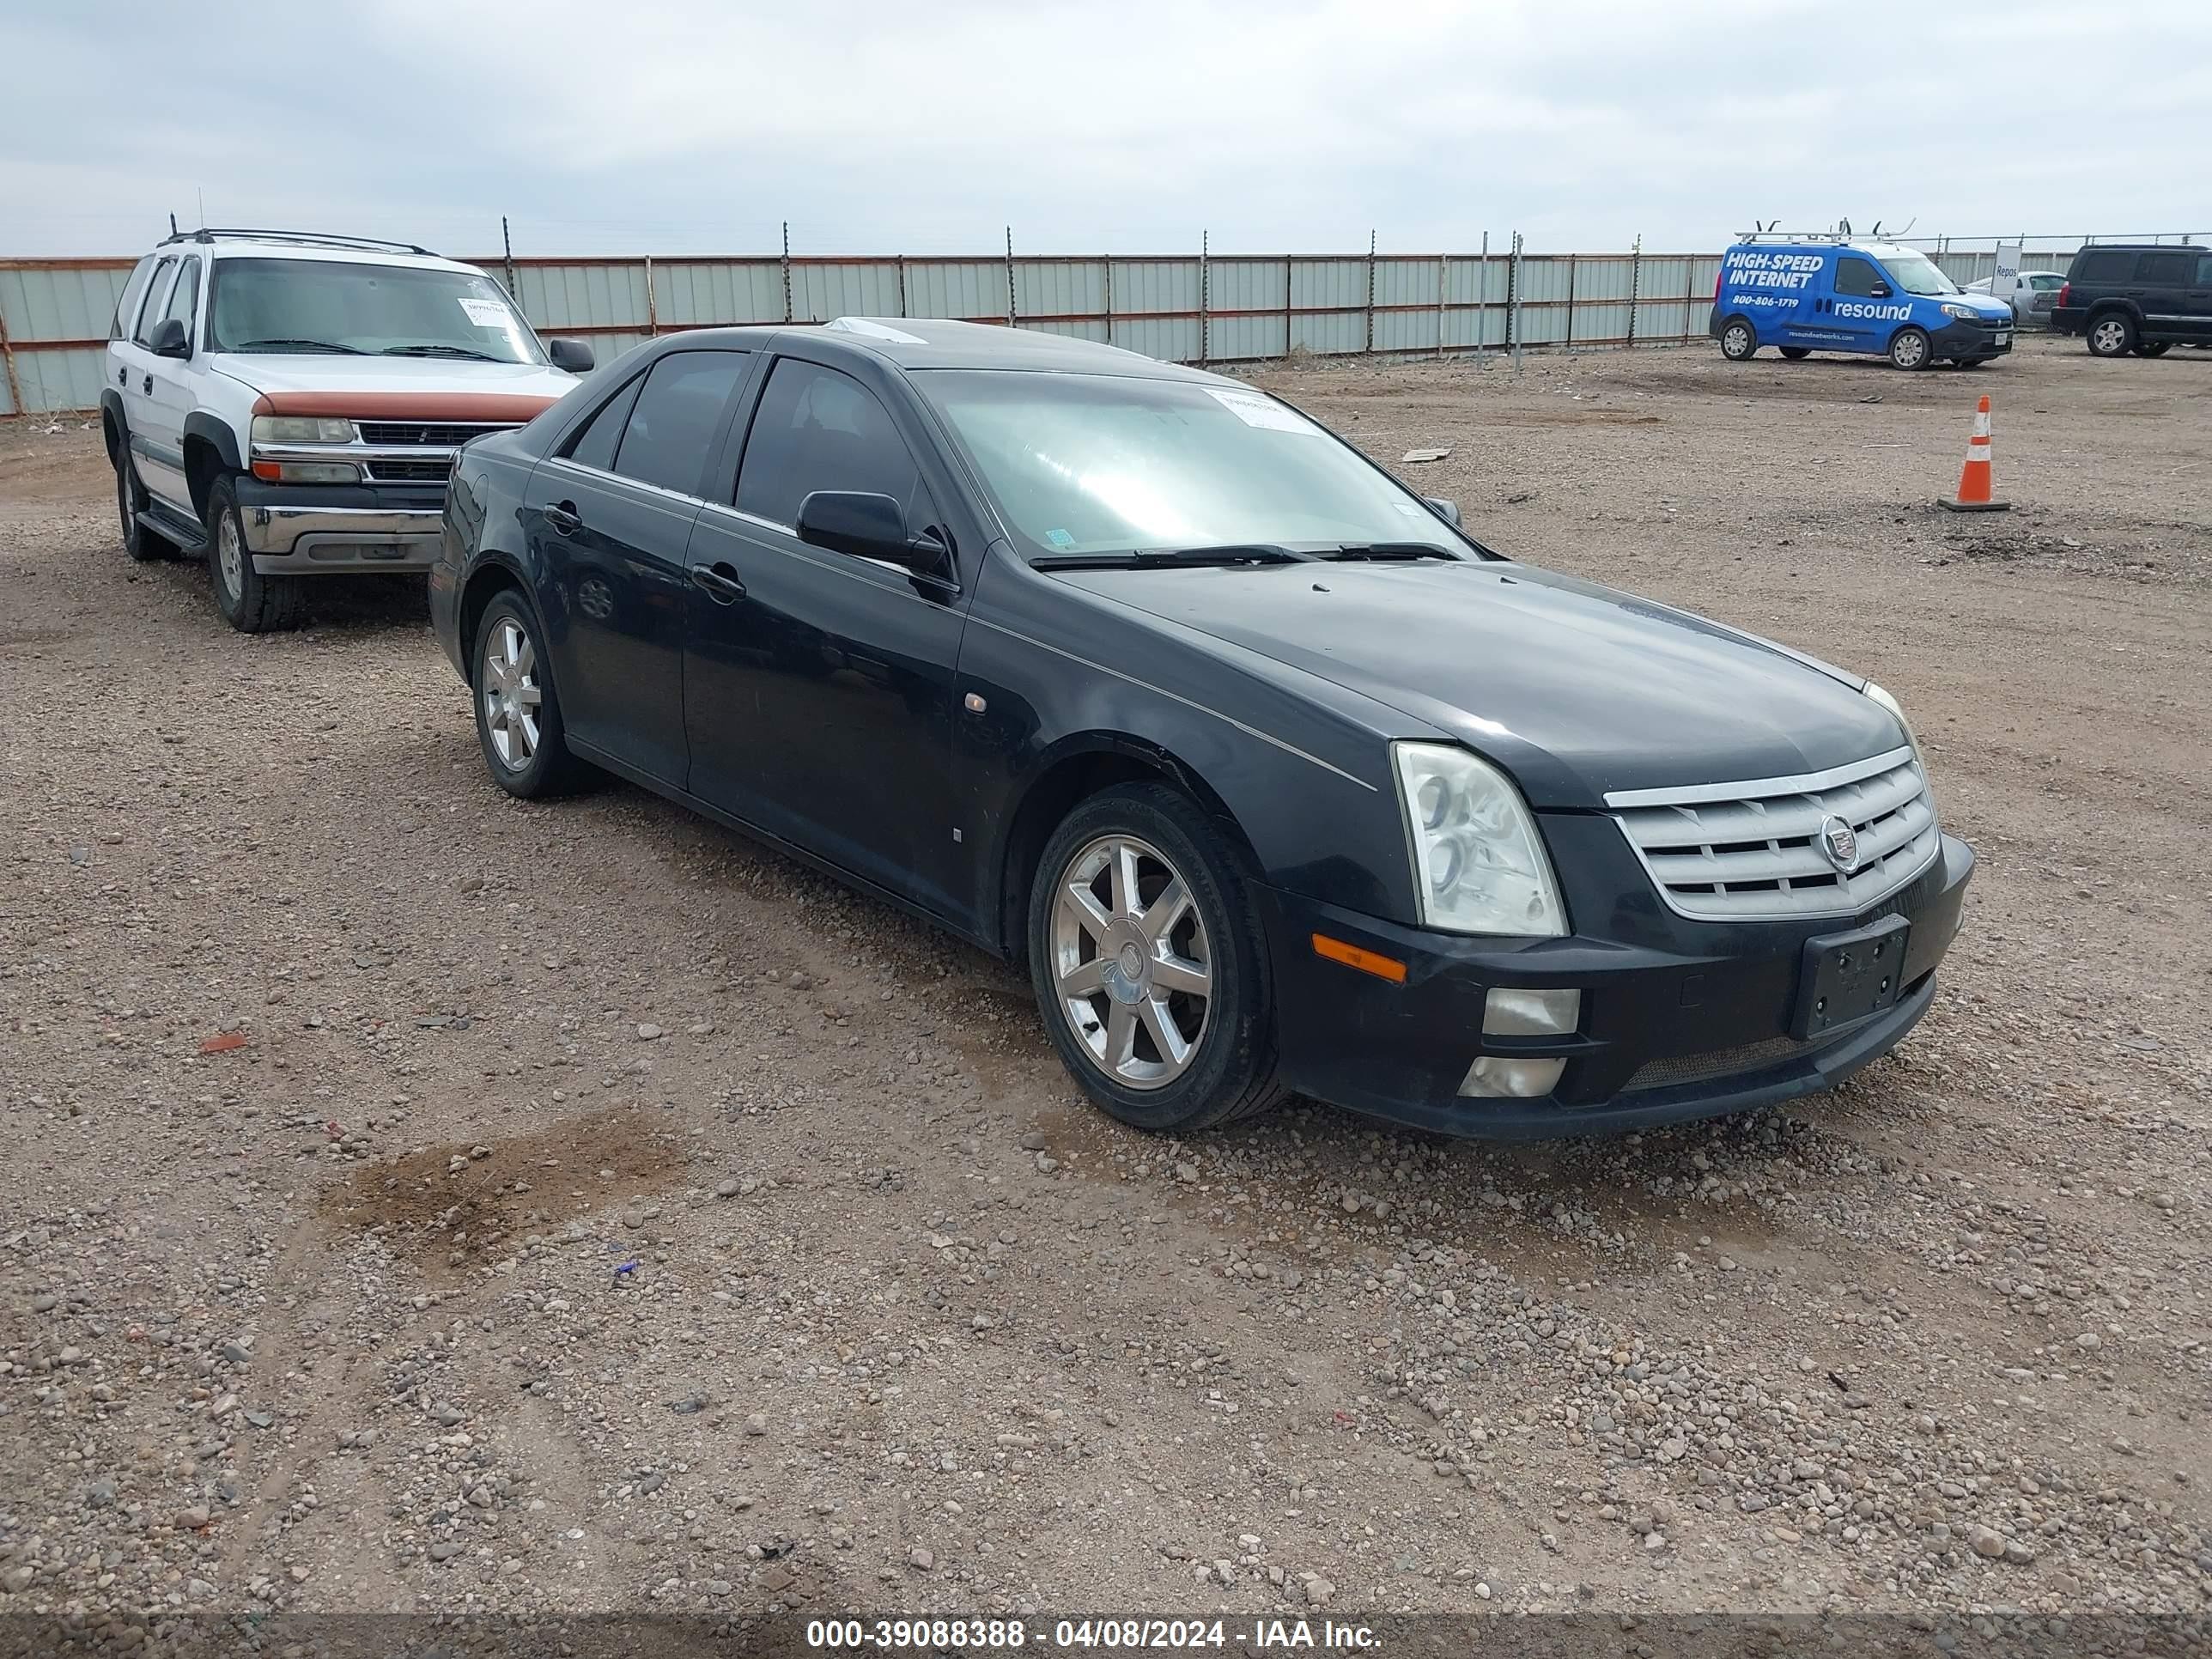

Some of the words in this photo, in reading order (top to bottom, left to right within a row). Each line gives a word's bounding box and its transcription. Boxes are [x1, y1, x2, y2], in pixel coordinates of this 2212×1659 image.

[1726, 252, 1823, 271] HIGH-SPEED
[1729, 270, 1813, 289] INTERNET
[1996, 265, 2017, 278] Repos
[1732, 295, 1799, 308] 800-806-1719
[1834, 302, 1912, 321] resound
[1789, 331, 1855, 342] resoundnetworks.com
